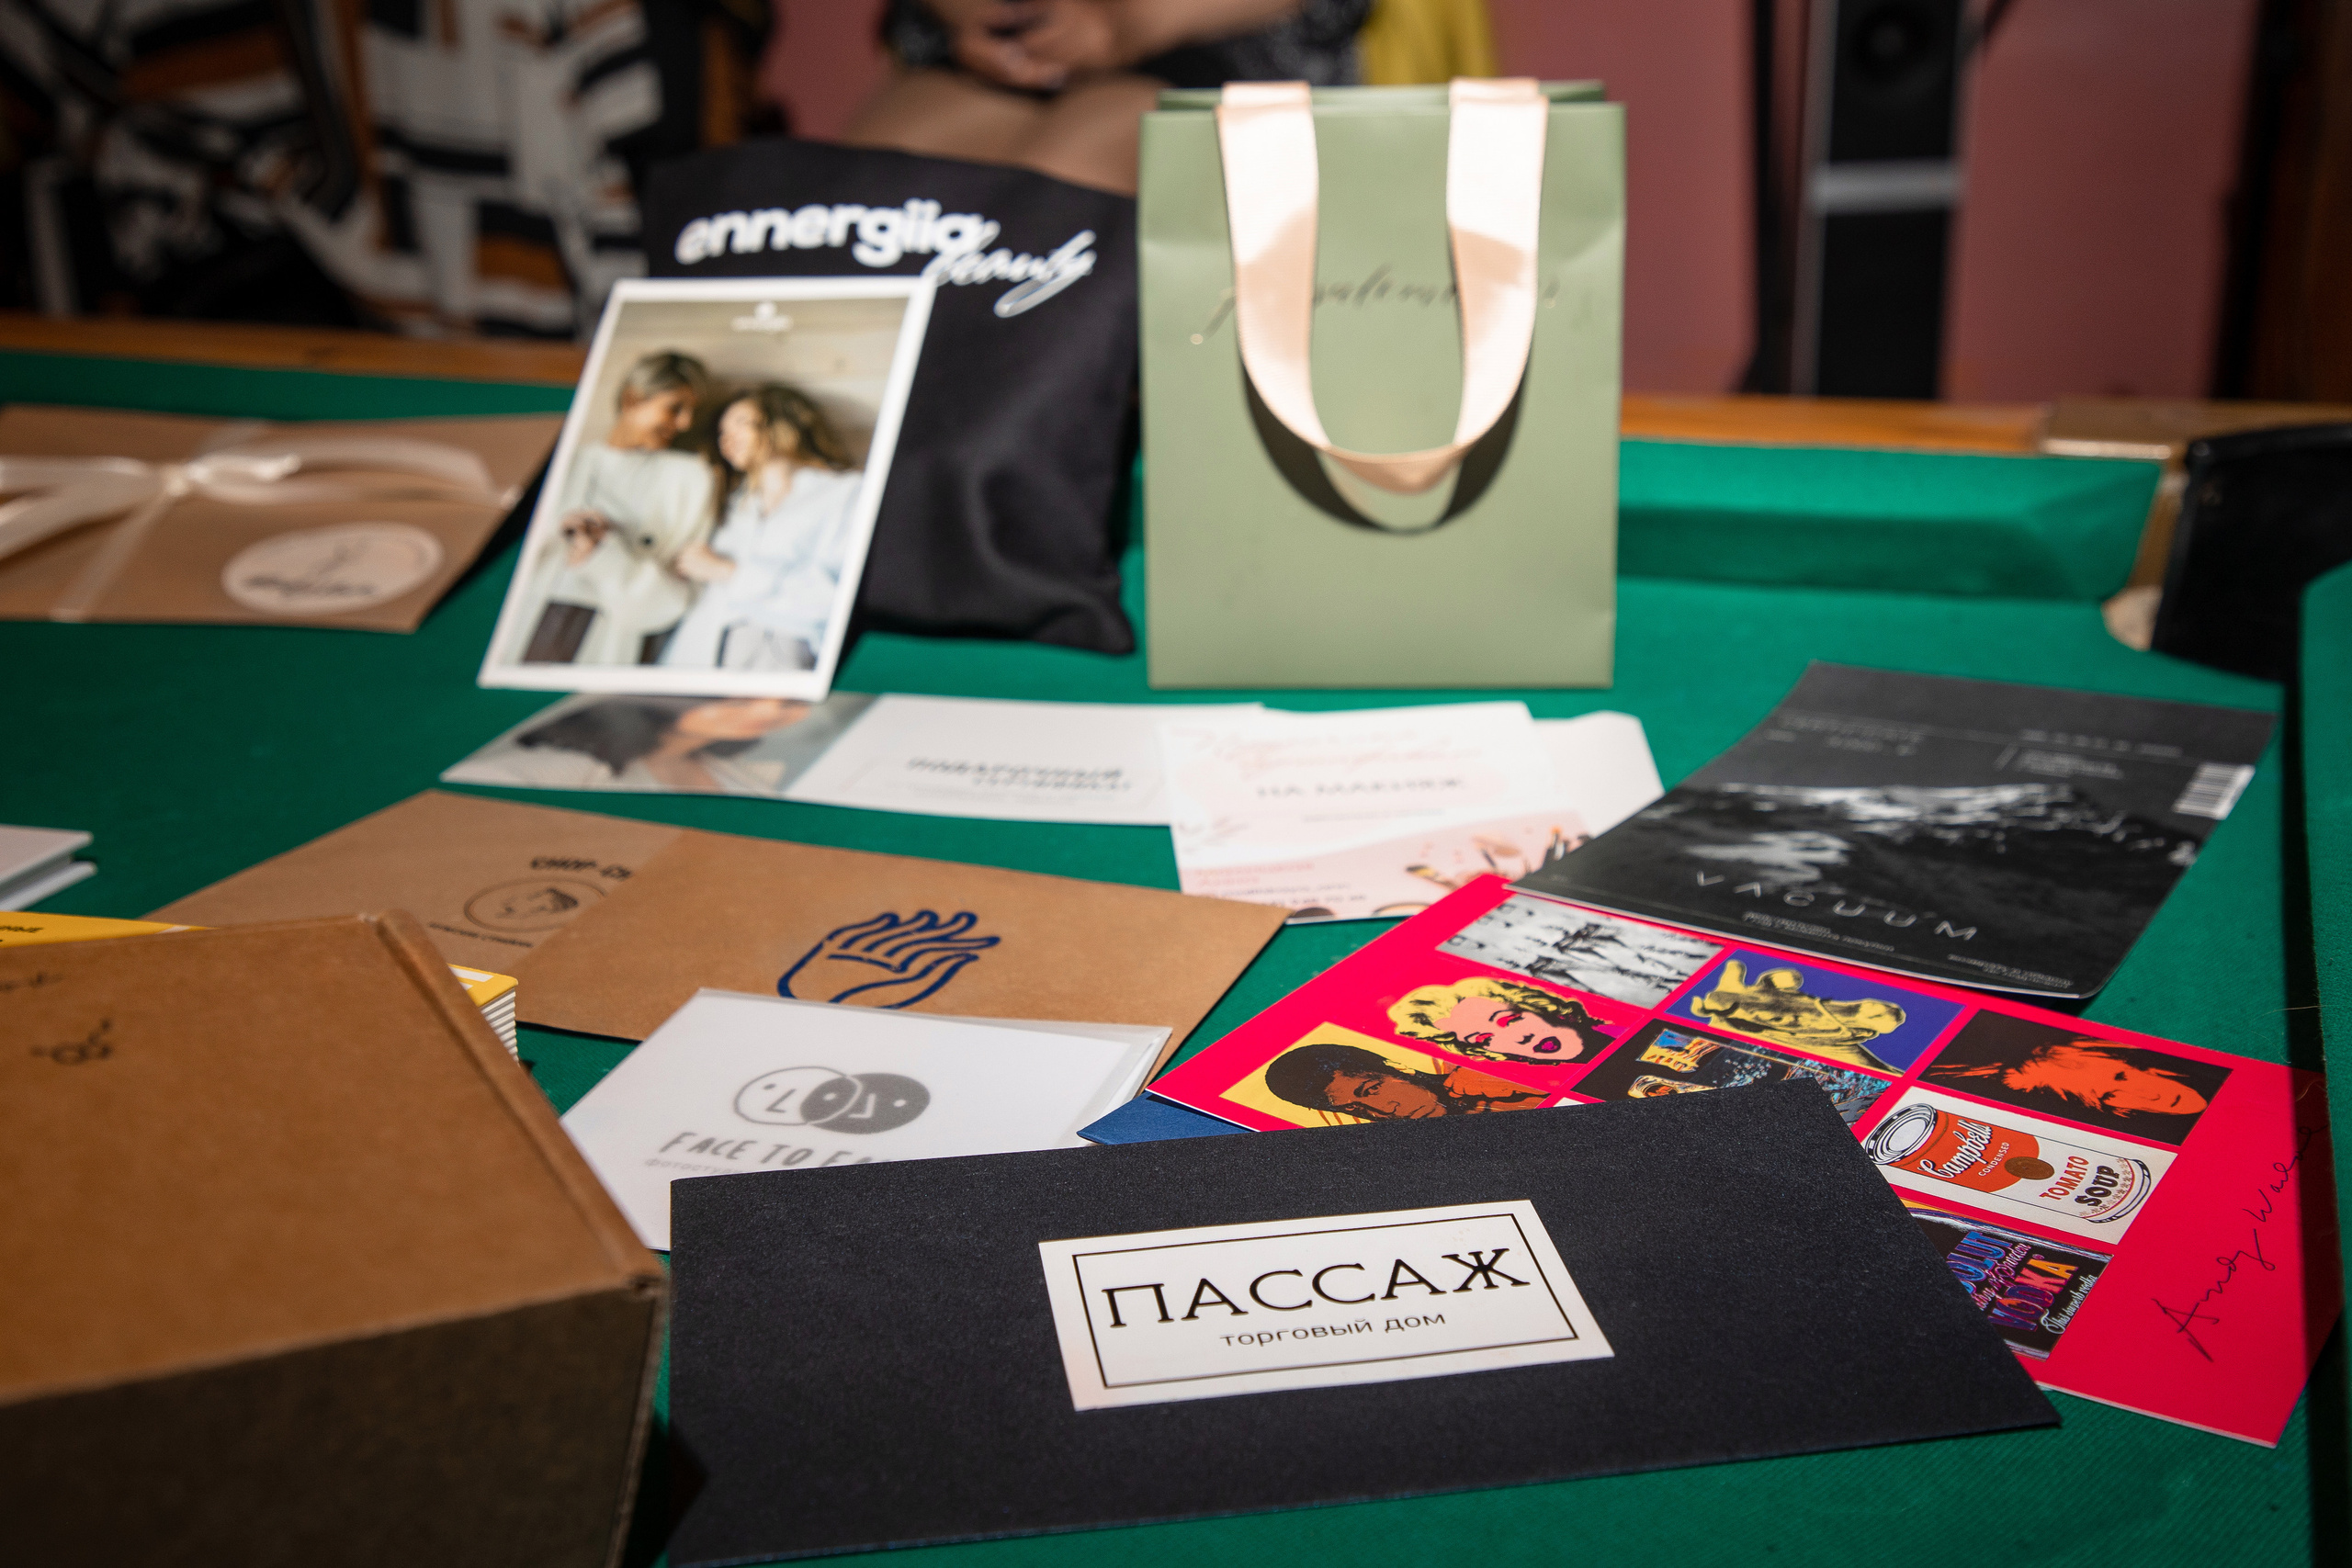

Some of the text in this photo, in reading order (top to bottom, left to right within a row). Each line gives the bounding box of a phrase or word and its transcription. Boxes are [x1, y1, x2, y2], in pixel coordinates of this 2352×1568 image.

[1697, 871, 1977, 942] VACUUM
[659, 1131, 759, 1160] FACE
[760, 1144, 814, 1167] TO
[1977, 1141, 2011, 1178] CONDENSED
[2039, 1156, 2089, 1201] TOMATO
[2075, 1165, 2120, 1207] SOUP
[1102, 1247, 1531, 1328] ПАССАЖ
[1219, 1314, 1446, 1348] торговый дом
